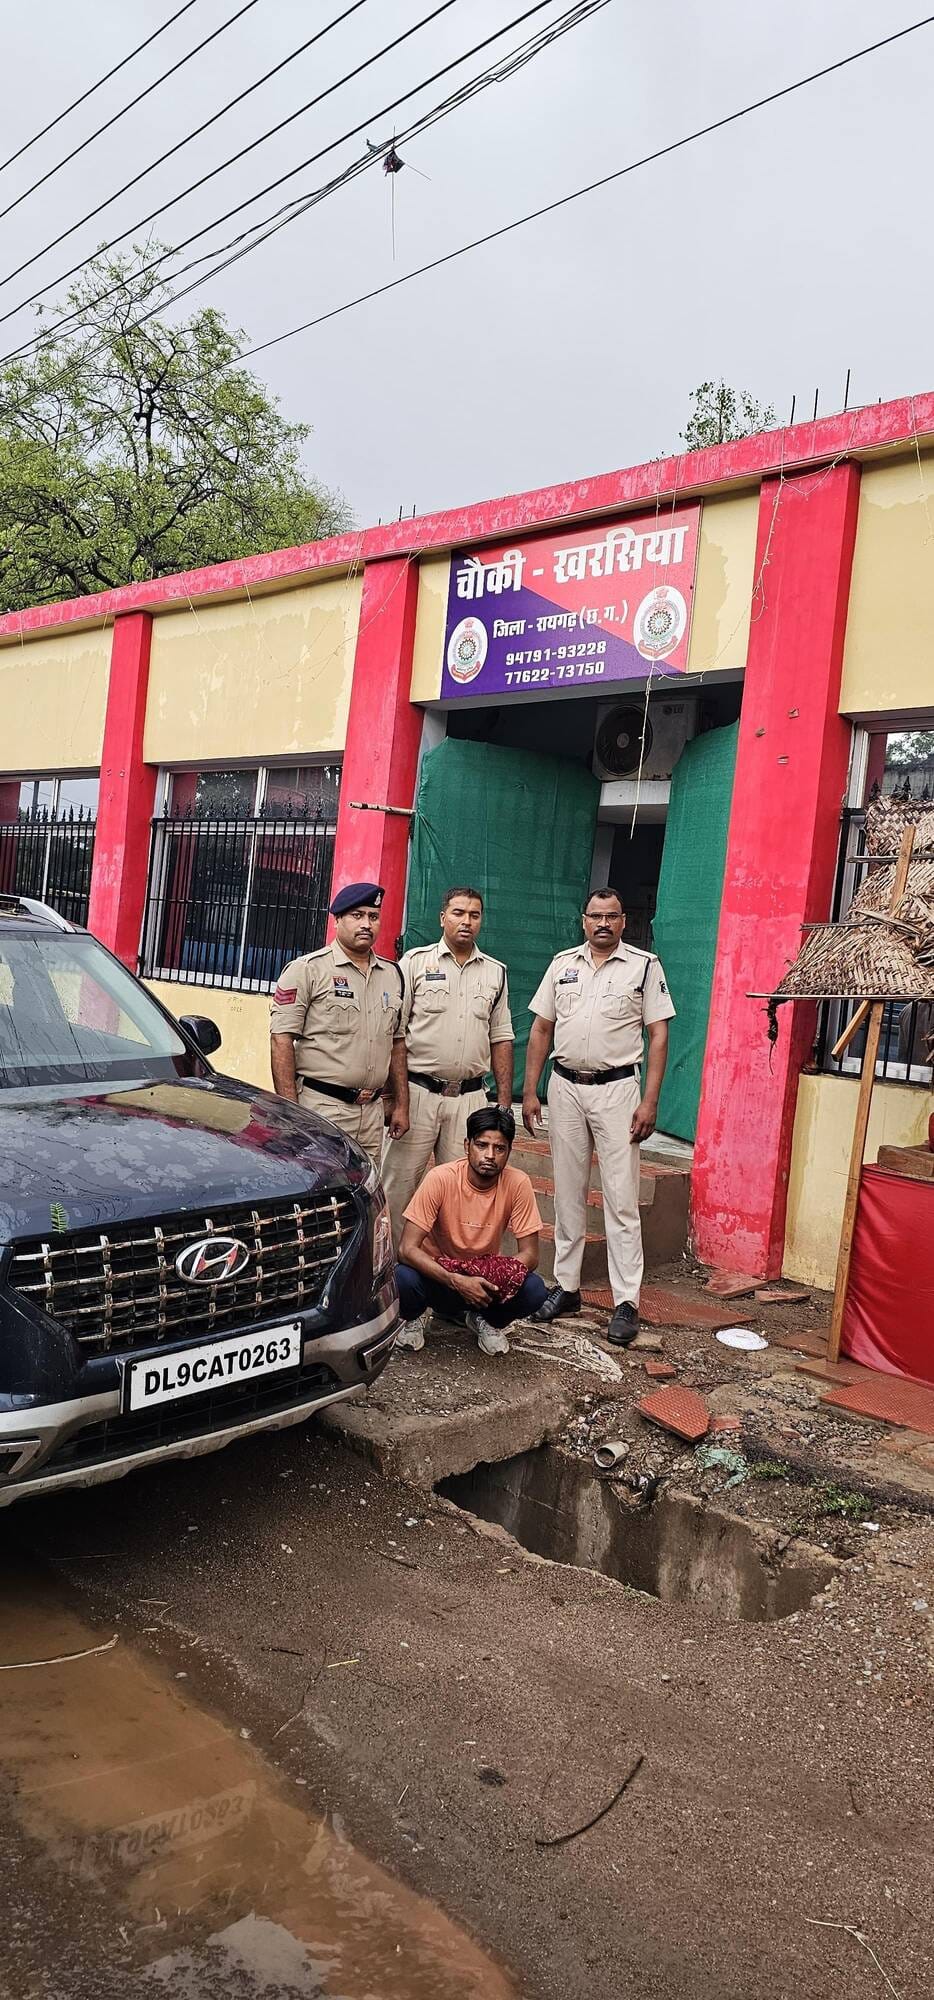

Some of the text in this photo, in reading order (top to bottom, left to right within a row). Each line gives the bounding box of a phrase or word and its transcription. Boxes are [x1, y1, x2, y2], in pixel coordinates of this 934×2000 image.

[456, 549, 526, 600] चौकी
[553, 526, 690, 584] खरसिया
[493, 619, 527, 639] जिला
[505, 641, 607, 666] 94791-93228
[505, 661, 605, 685] 77622-73750
[144, 1337, 291, 1396] DL9CAT0263
